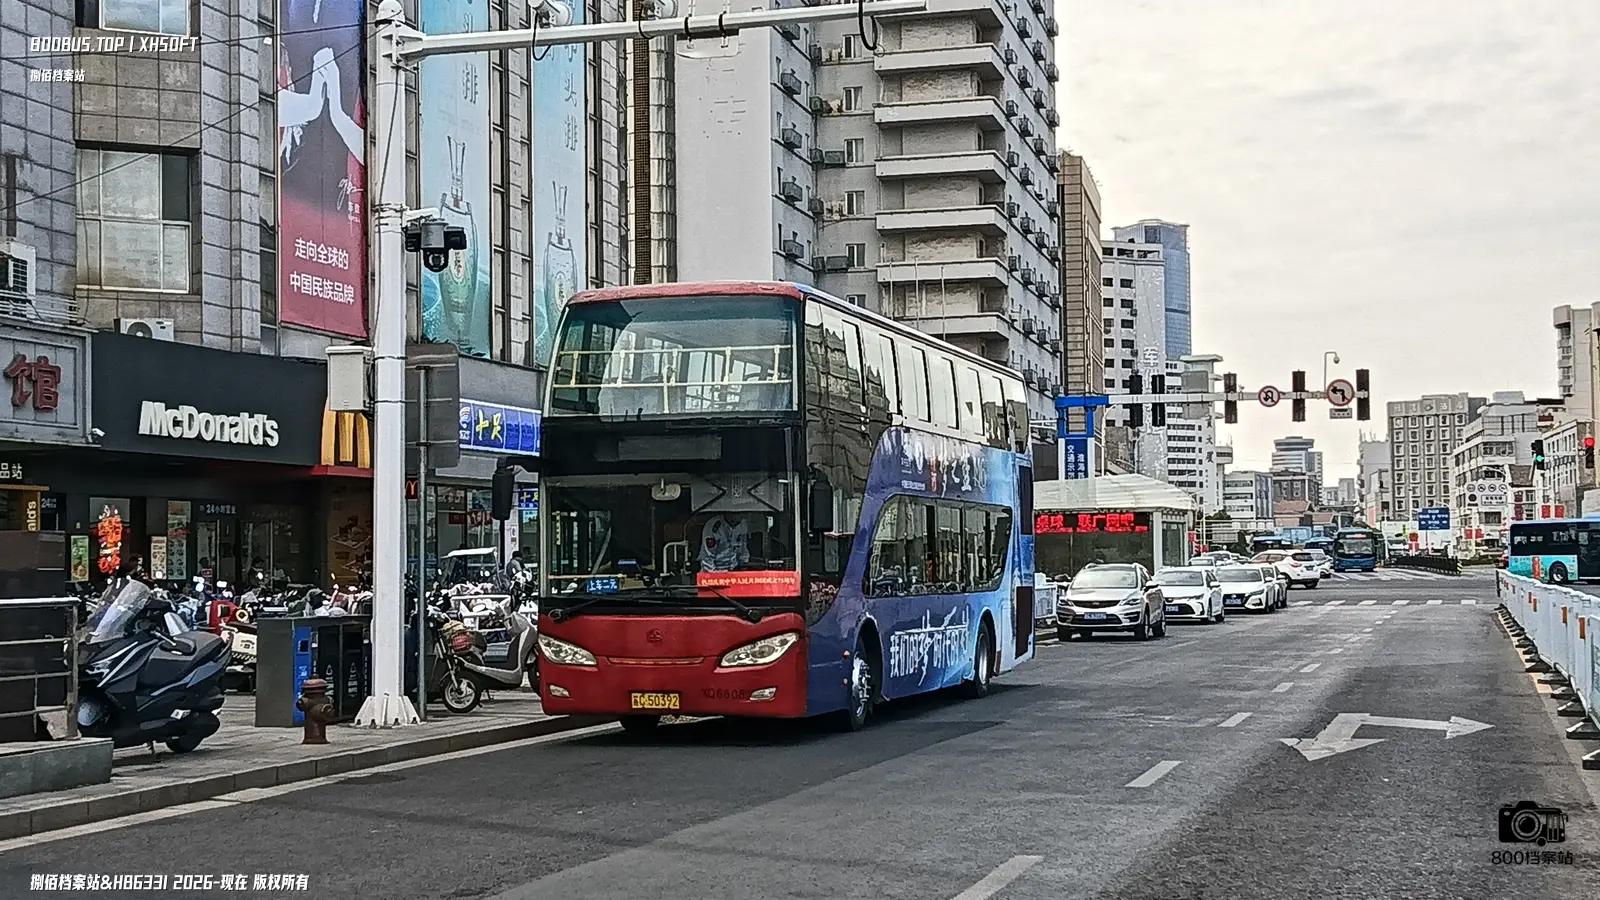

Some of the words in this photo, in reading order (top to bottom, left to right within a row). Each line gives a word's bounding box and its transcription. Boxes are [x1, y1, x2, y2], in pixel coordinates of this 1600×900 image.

[294, 236, 349, 270] 走向全球的
[289, 270, 355, 306] 中国民族品牌
[3, 353, 62, 411] 馆
[138, 400, 280, 448] McDonald's
